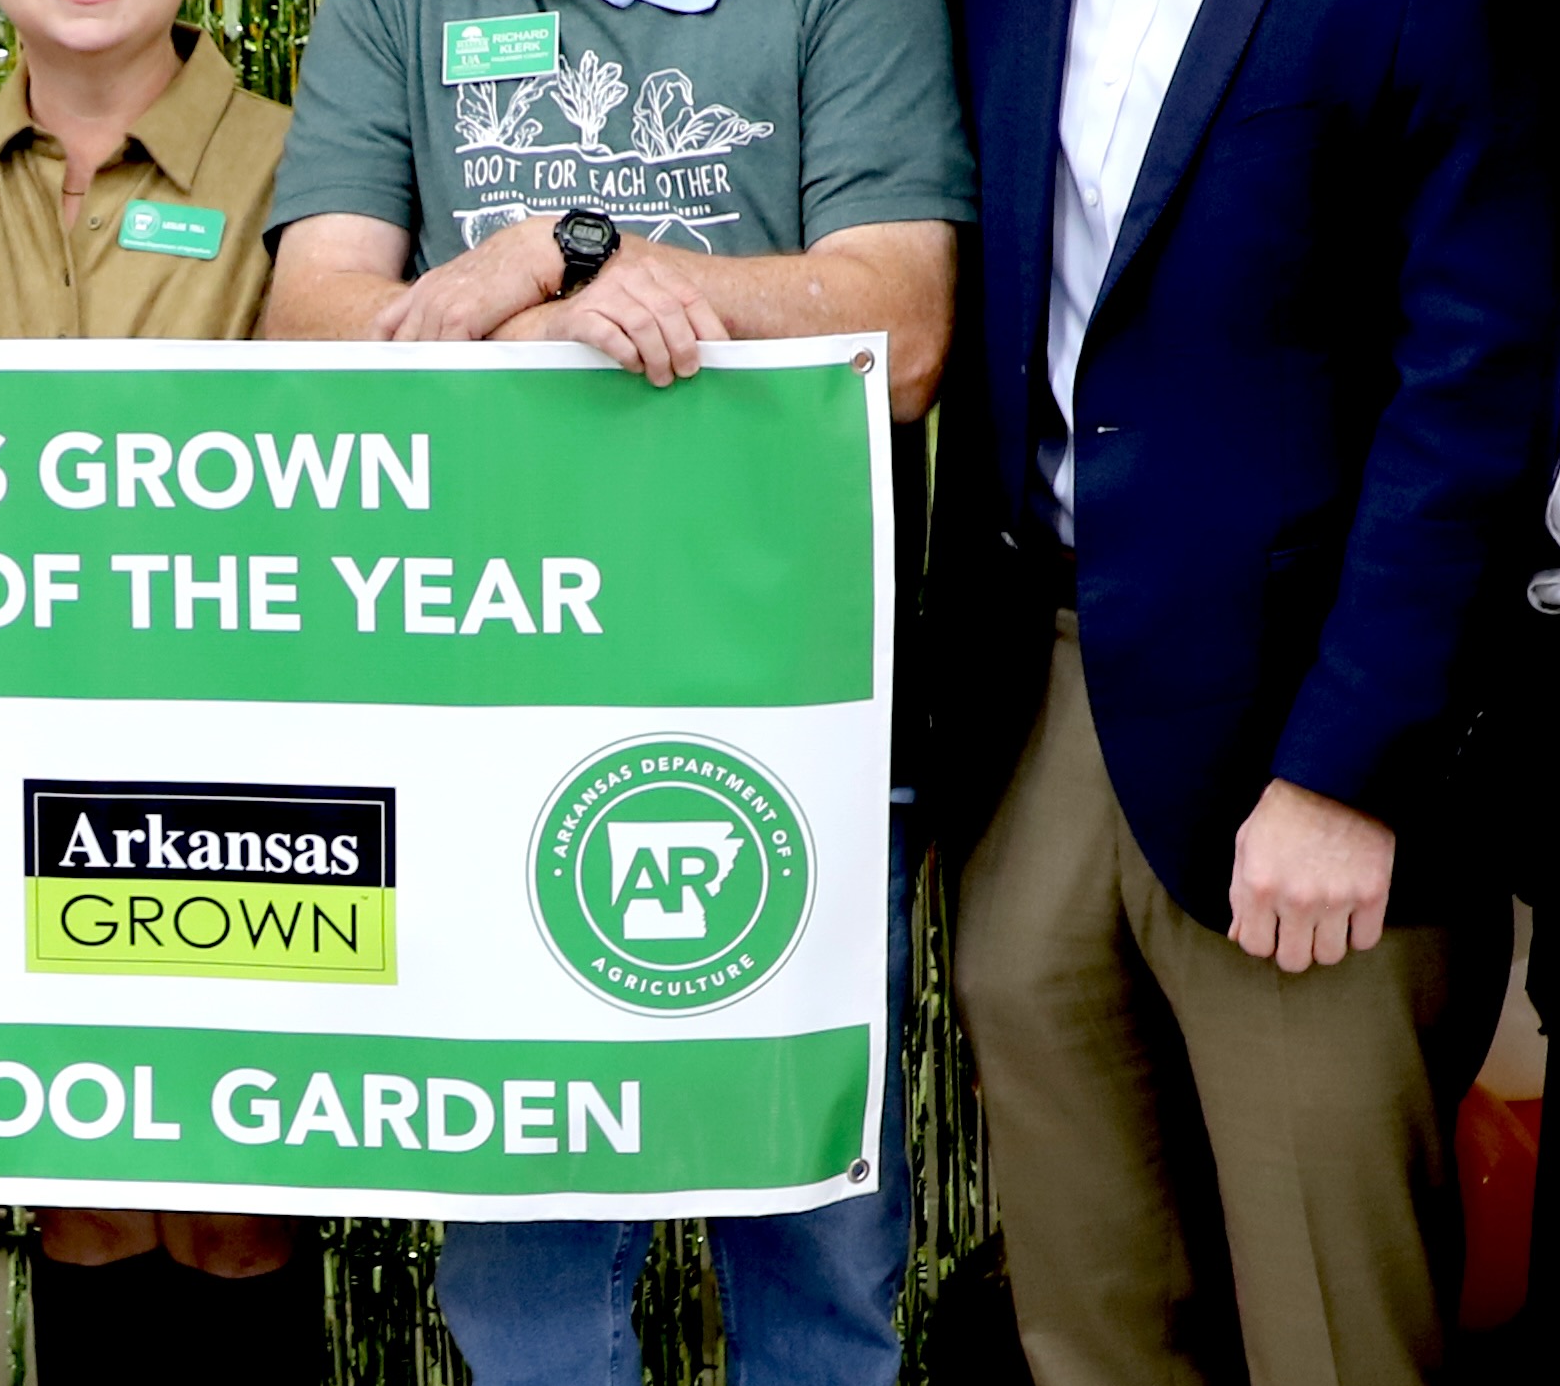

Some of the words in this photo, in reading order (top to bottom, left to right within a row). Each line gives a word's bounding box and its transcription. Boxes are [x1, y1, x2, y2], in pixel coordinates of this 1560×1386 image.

[492, 28, 549, 44] RICHARD
[464, 154, 523, 189] ROOT
[534, 159, 577, 190] FOR
[589, 165, 646, 197] EACH
[655, 163, 731, 200] OTHER
[39, 431, 431, 511] GROWN
[111, 554, 302, 632] THE
[331, 556, 604, 636] YEAR
[553, 765, 633, 858] ARKANSAS
[640, 756, 777, 823] DEPARTMENT
[771, 829, 792, 858] OF
[58, 811, 360, 876] Arkansas
[615, 847, 721, 913] AR
[60, 894, 358, 954] GROWN
[591, 953, 755, 996] AGRICULTURE
[210, 1068, 642, 1154] GARDEN
